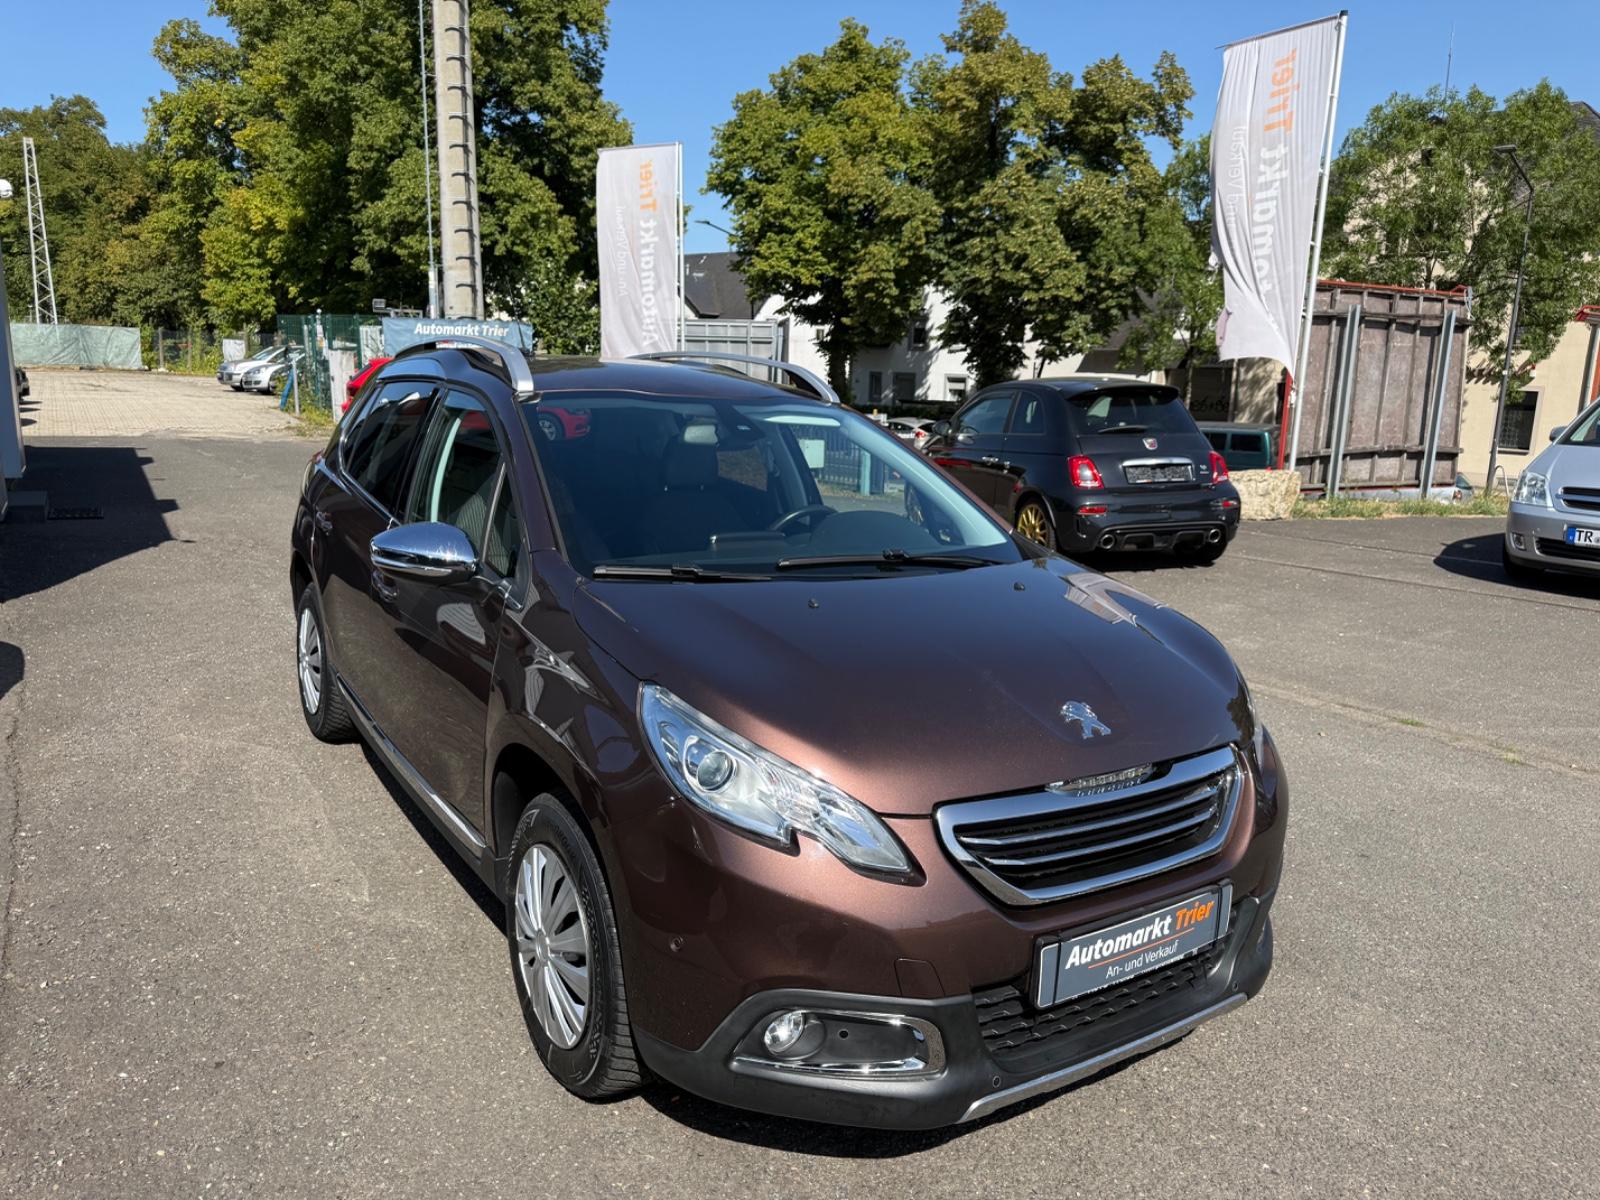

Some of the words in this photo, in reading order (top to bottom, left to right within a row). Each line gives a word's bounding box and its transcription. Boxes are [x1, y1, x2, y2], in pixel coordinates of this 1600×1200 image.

[414, 323, 480, 336] Automarkt
[482, 325, 510, 337] Trier
[1575, 530, 1593, 543] TR
[1065, 915, 1172, 970] Automarkt
[1176, 900, 1216, 930] Trier
[1105, 962, 1124, 980] An-
[1124, 953, 1144, 972] und
[1144, 939, 1180, 965] Verkauf
